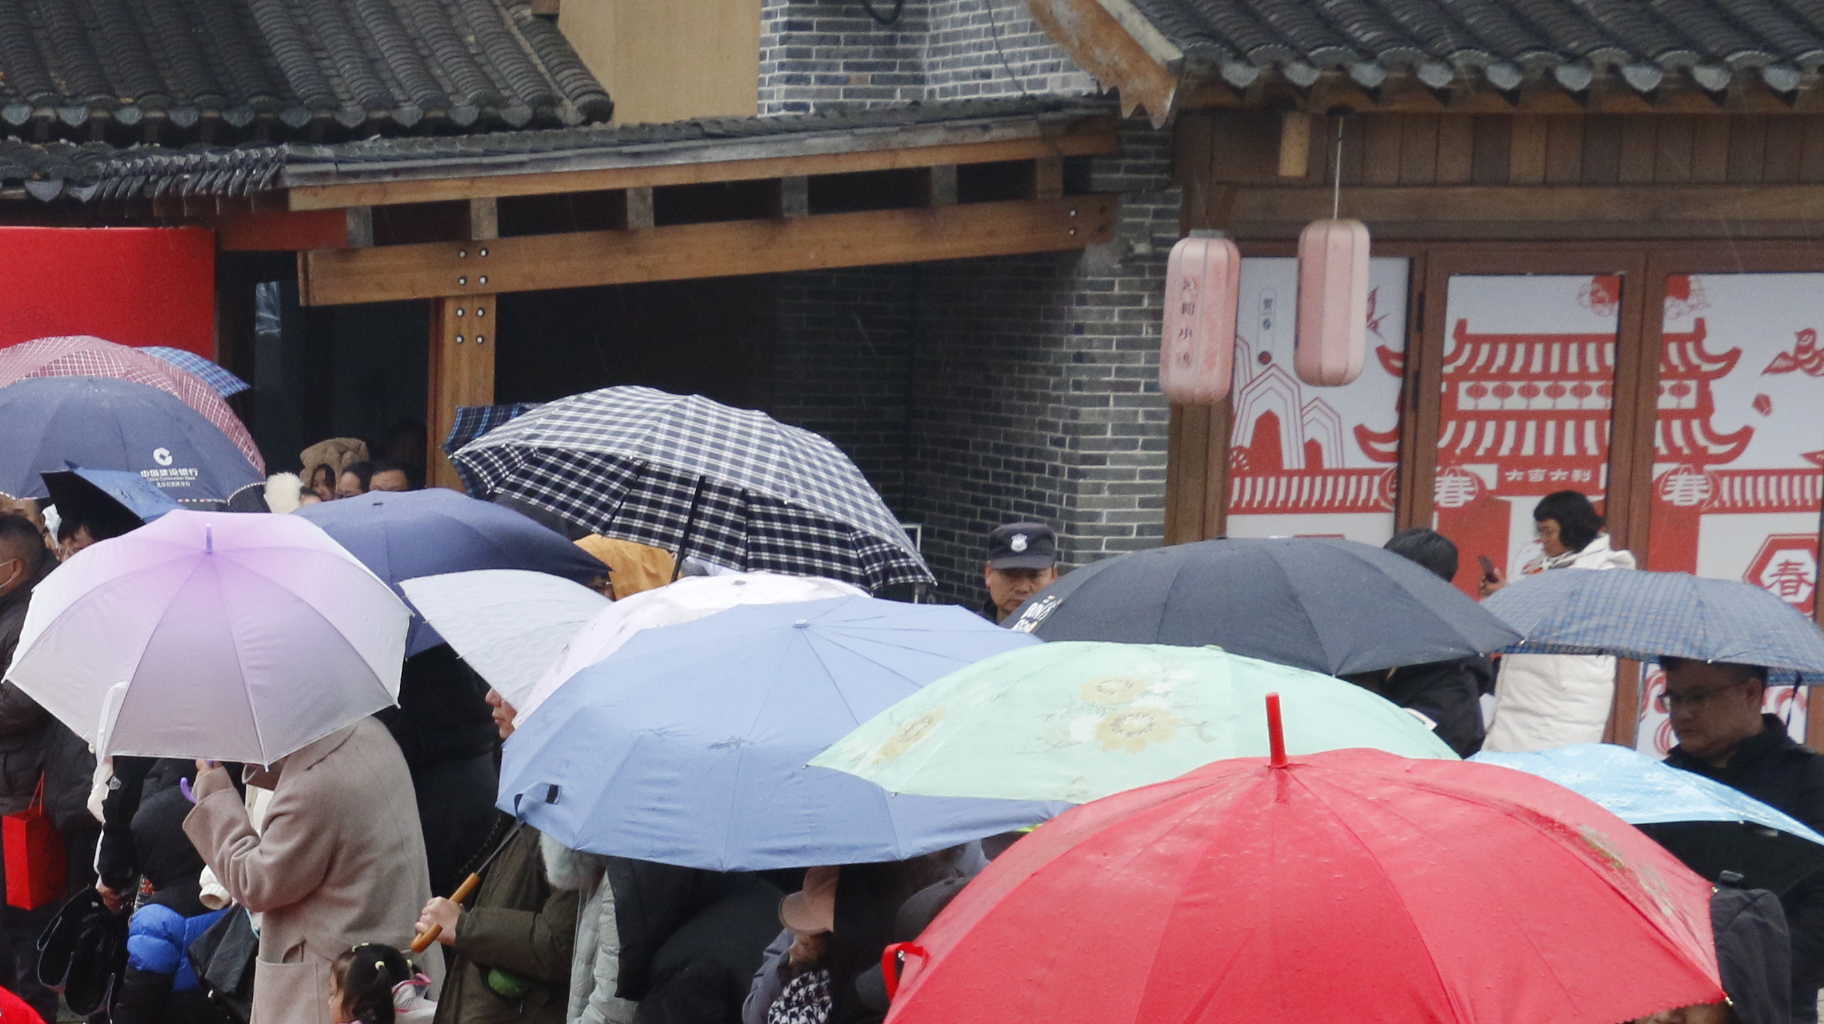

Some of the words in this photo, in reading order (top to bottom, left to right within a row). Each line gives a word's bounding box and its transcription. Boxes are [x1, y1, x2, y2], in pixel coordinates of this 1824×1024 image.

[1435, 475, 1478, 508] 春
[1505, 468, 1591, 483] 大吉大利
[1662, 474, 1710, 507] 春
[1769, 559, 1816, 597] 春
